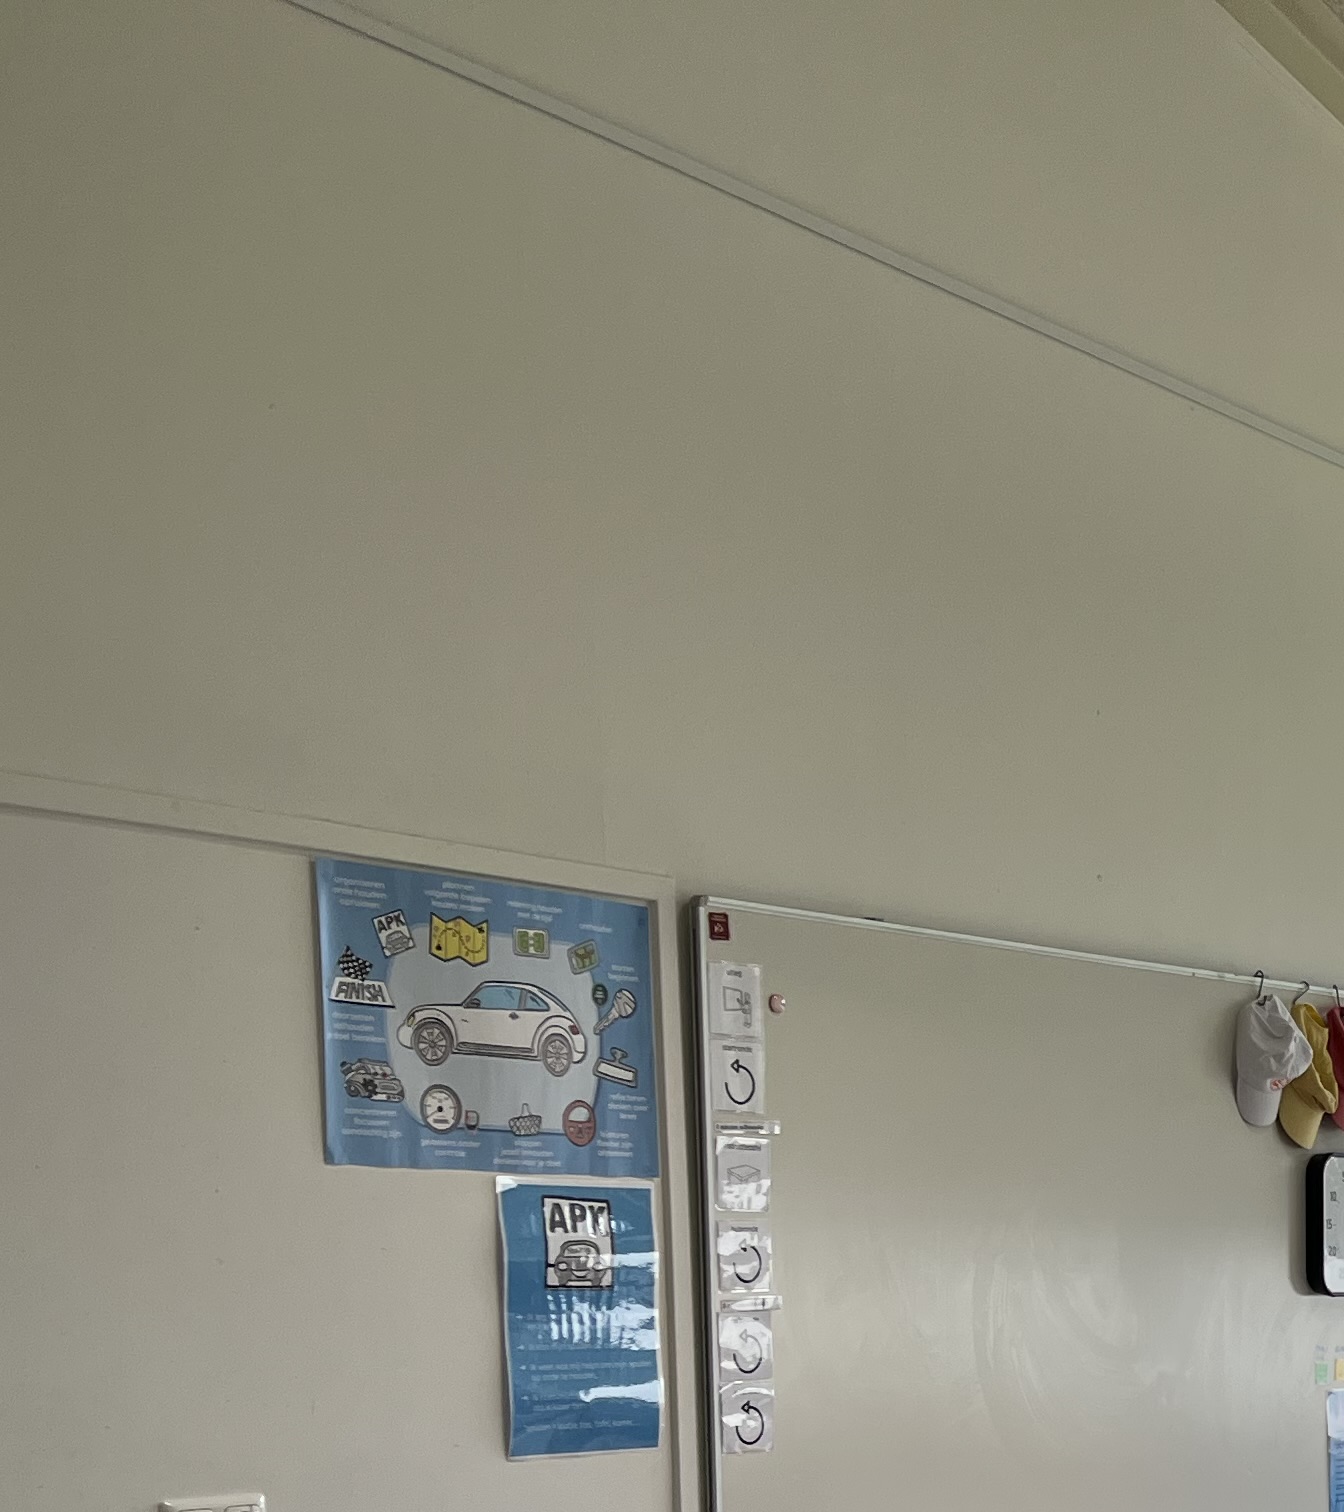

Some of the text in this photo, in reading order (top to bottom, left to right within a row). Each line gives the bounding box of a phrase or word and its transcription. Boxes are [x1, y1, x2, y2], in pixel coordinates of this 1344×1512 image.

[376, 913, 406, 933] APK
[335, 980, 387, 1003] FINISH
[1330, 1191, 1337, 1201] 10
[548, 1202, 606, 1238] APK
[1326, 1219, 1333, 1229] 15
[1328, 1246, 1337, 1256] 20
